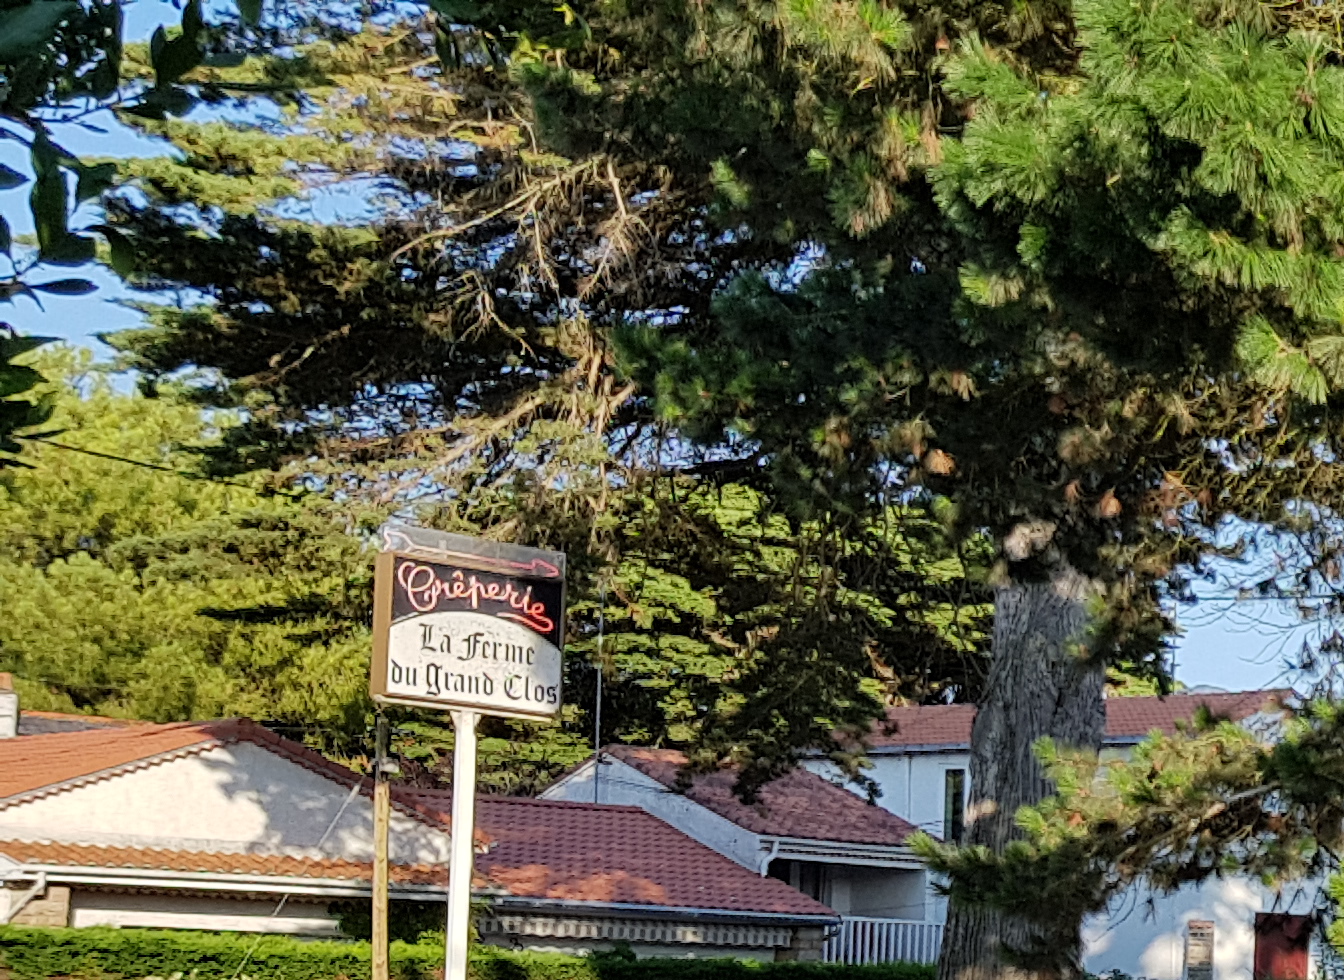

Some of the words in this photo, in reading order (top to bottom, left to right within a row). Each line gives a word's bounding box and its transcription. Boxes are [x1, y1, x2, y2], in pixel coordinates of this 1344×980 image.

[397, 561, 554, 632] Crêperie
[419, 623, 451, 654] La
[457, 632, 535, 665] Ferme
[391, 659, 417, 687] du
[504, 674, 558, 704] Clos
